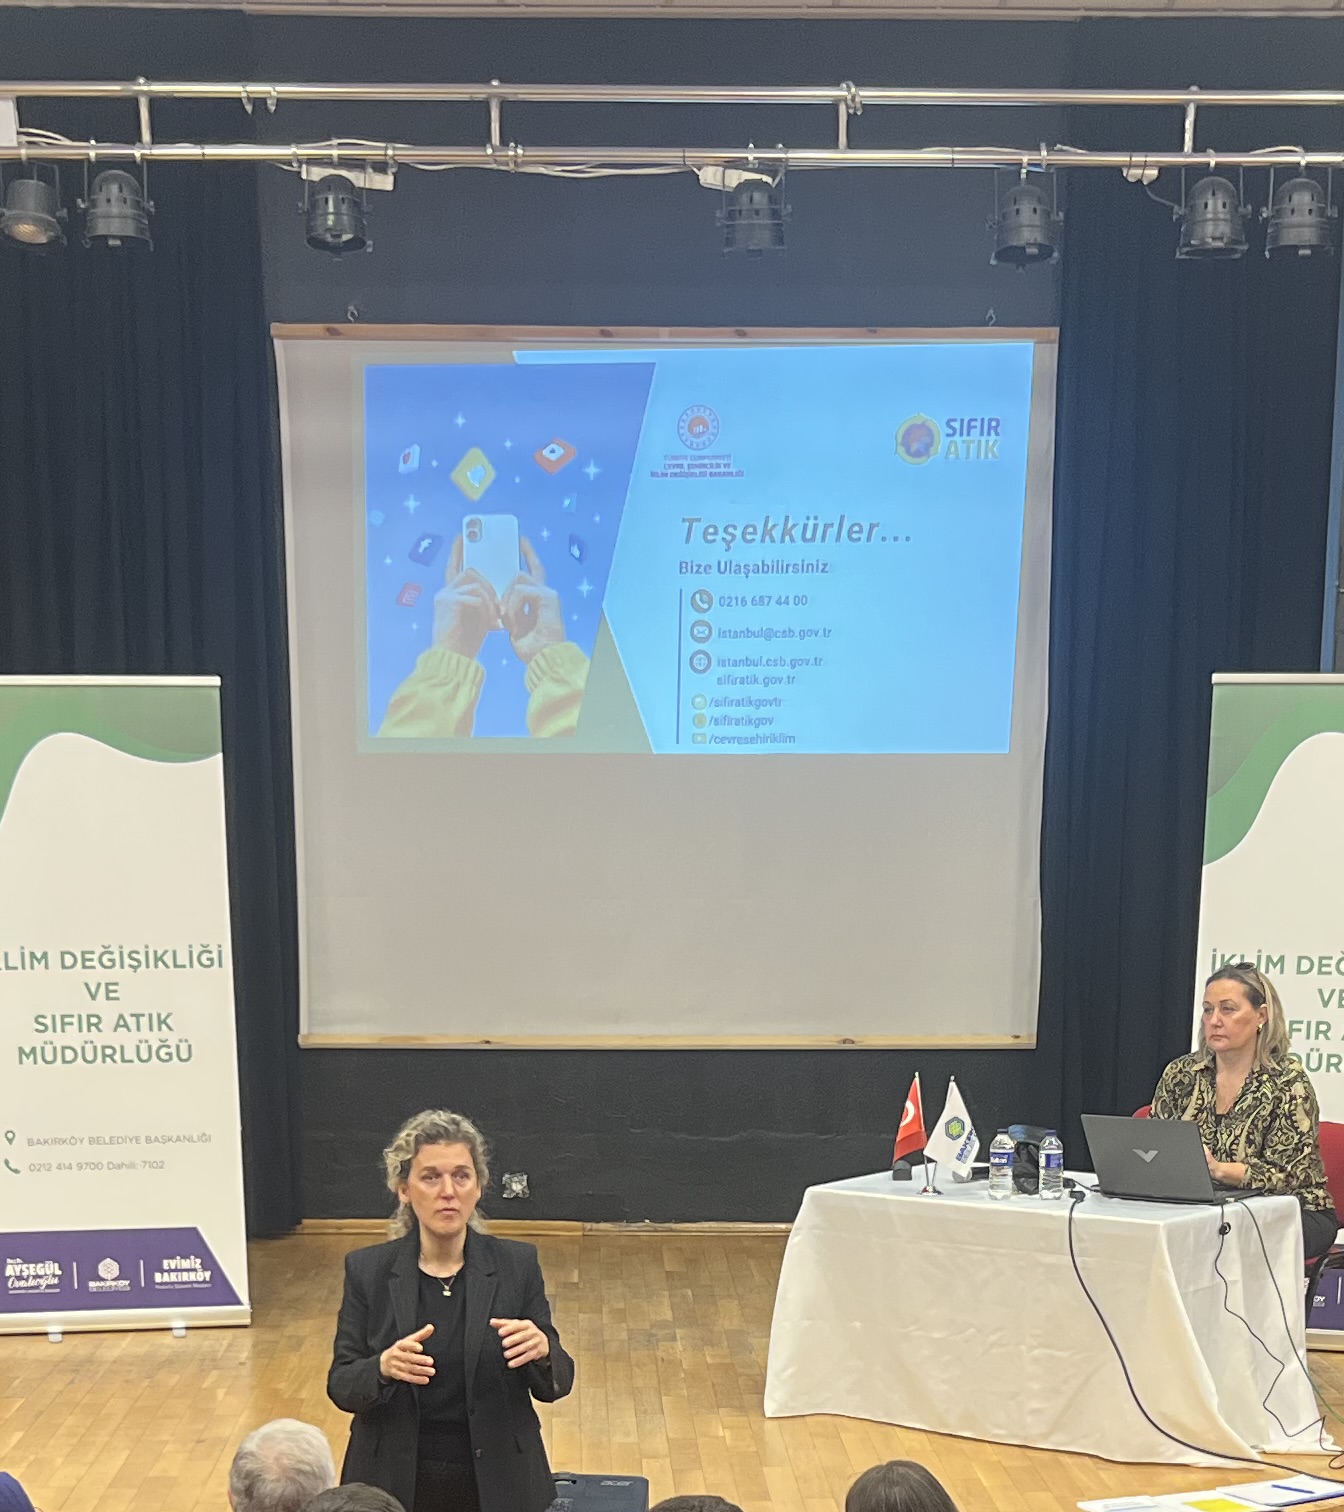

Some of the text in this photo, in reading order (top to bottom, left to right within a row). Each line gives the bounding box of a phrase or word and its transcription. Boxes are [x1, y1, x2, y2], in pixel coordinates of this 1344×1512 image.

[945, 417, 1001, 437] SIFIR
[945, 439, 1000, 460] ATIK
[681, 514, 912, 552] Teşekkürler...
[679, 560, 712, 575] Bize
[718, 595, 748, 607] 0216
[775, 595, 790, 606] 44
[793, 595, 808, 606] 00
[59, 944, 224, 973] DEĞİŞİKLİĞİ
[83, 981, 121, 1001] VE
[33, 1012, 174, 1034] SIFIR ATIK
[1287, 1020, 1332, 1041] FIR
[17, 1039, 193, 1065] MÜDÜRLÜĞÜ
[27, 1132, 212, 1147] BAKIRKÖY BELEDİYE BAŞKANLIĞI
[28, 1163, 53, 1172] 0212
[76, 1162, 104, 1171] 9700
[141, 1160, 165, 1170] 7102
[5, 1260, 62, 1278] AYŞEGÜL
[162, 1255, 202, 1270] EVİMİZ
[154, 1268, 212, 1284] BAKIRKÖY
